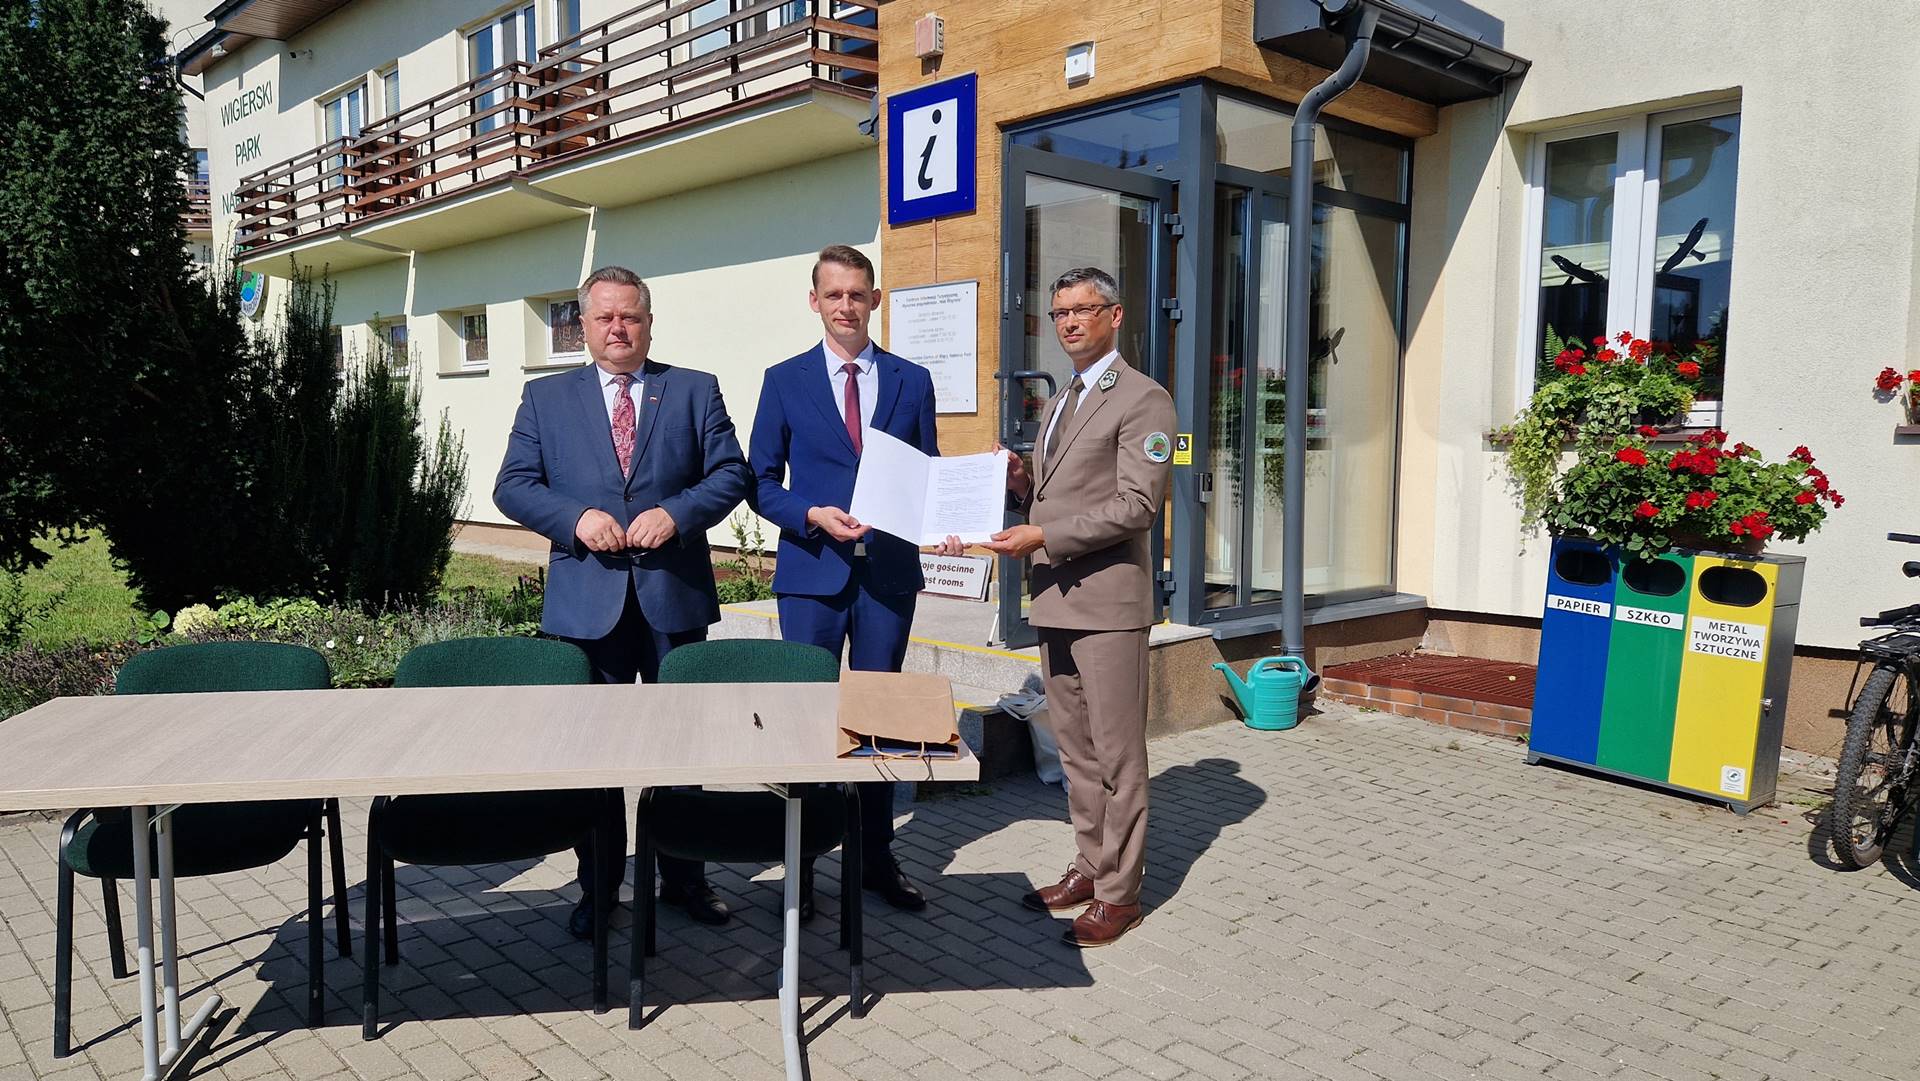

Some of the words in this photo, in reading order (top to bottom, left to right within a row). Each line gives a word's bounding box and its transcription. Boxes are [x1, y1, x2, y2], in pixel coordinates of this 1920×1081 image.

[221, 80, 273, 127] WIGIERSKI
[235, 134, 262, 167] PARK
[921, 561, 935, 571] oje
[936, 562, 975, 574] gościnne
[924, 576, 936, 585] est
[938, 578, 964, 587] rooms
[1556, 598, 1601, 614] PAPIER
[1627, 609, 1671, 625] SZKŁO
[1708, 621, 1748, 635] METAL
[1693, 630, 1760, 649] TWORZYWA
[1695, 642, 1757, 660] SZTUCZNE
